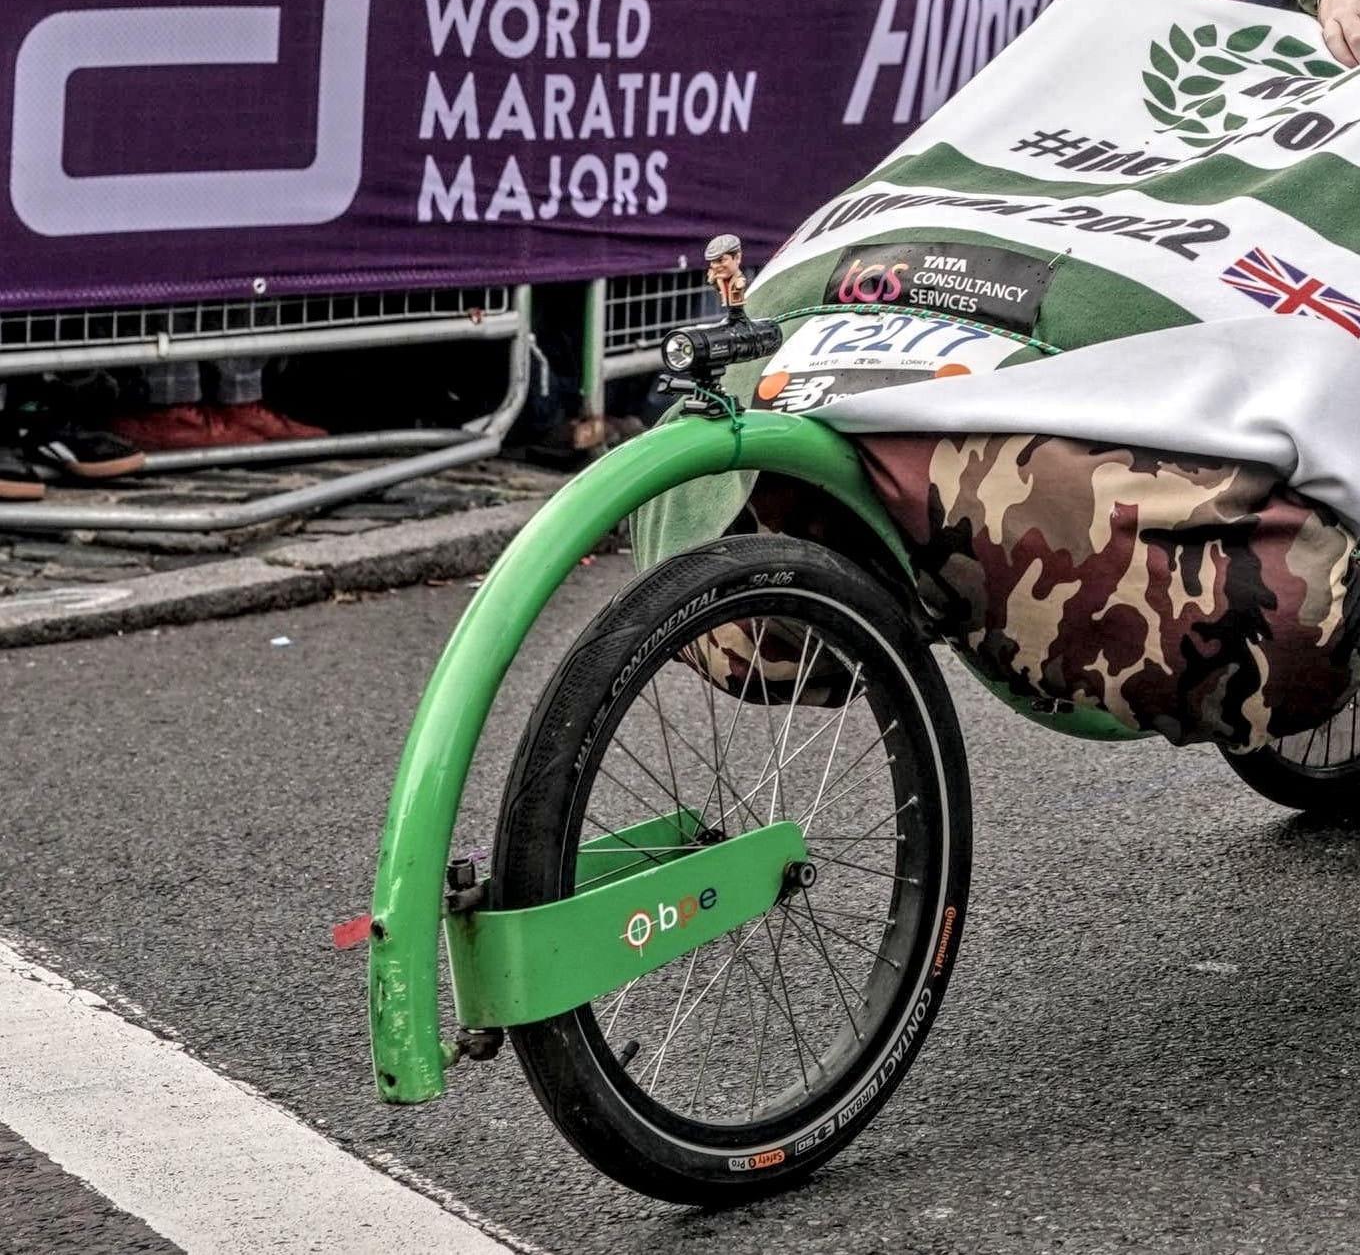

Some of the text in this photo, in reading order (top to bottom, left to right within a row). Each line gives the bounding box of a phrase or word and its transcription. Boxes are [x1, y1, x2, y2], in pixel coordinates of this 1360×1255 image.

[419, 69, 758, 141] MARATHON
[417, 150, 669, 224] MAJORS
[1028, 205, 1231, 261] 2022
[913, 271, 1029, 303] CONSULTANCY
[923, 255, 967, 273] TATA
[909, 288, 978, 314] SERVICES
[811, 316, 991, 357] 12277
[611, 587, 718, 696] CONTINENTAL
[876, 987, 932, 1090] CONTACT
[841, 1084, 879, 1125] URBAN
